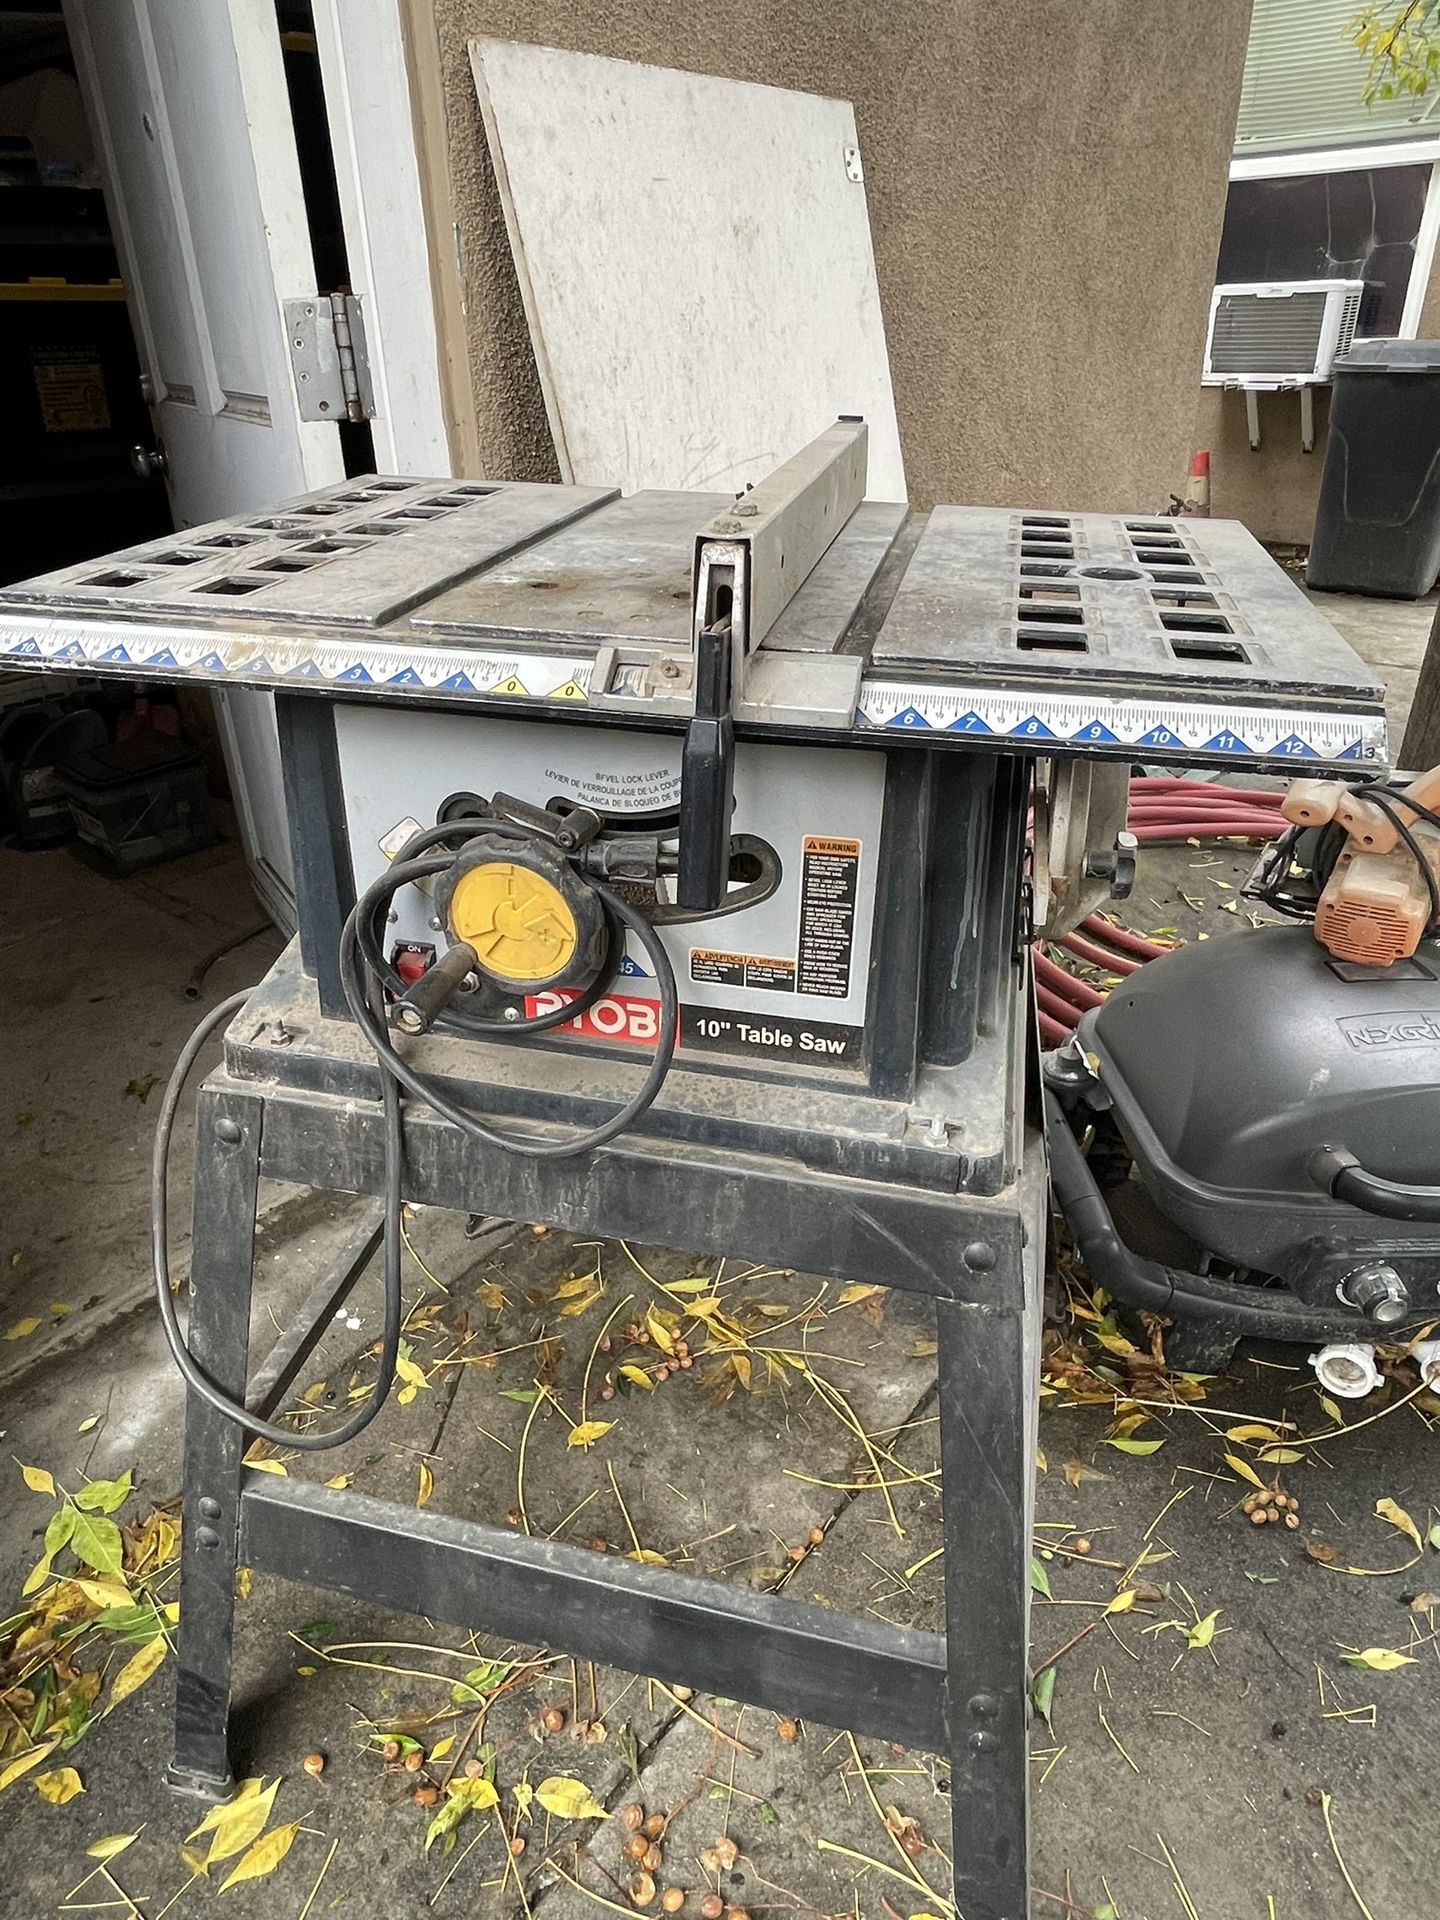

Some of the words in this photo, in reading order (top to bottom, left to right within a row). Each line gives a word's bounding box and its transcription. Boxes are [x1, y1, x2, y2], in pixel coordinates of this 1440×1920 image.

[20, 641, 36, 653] 10
[66, 645, 78, 656] 9
[111, 649, 122, 660] 8
[158, 652, 170, 663] 7
[204, 656, 216, 667] 6
[252, 660, 264, 671] 5
[301, 665, 311, 675] 4
[350, 668, 362, 679] 3
[400, 673, 412, 684] 2
[454, 677, 463, 687] 1
[507, 681, 516, 692] 0
[565, 686, 574, 697] 0
[903, 713, 915, 725] 6
[964, 717, 977, 729] 7
[1026, 721, 1038, 734] 8
[1089, 726, 1102, 738] 9
[1151, 731, 1171, 744] 10
[1218, 735, 1235, 749] 11
[1285, 740, 1304, 754] 12
[545, 769, 570, 785] LEVIER
[570, 778, 580, 788] DE
[582, 782, 636, 796] VERROUILLAGE
[637, 786, 648, 796] DE
[648, 785, 660, 794] LA
[622, 775, 643, 784] LOCK
[645, 769, 670, 782] LEVER
[577, 791, 610, 806] PALANCA
[611, 799, 622, 807] DE
[624, 796, 660, 807] BLOQUEO
[661, 792, 673, 802] DE
[818, 842, 858, 853] WARNING
[407, 944, 422, 953] ON
[704, 952, 744, 963] ADVERTENCIA
[532, 991, 662, 1038] RYOB
[696, 1019, 731, 1038] 10"
[737, 1023, 794, 1048] Table
[799, 1032, 846, 1055] Saw
